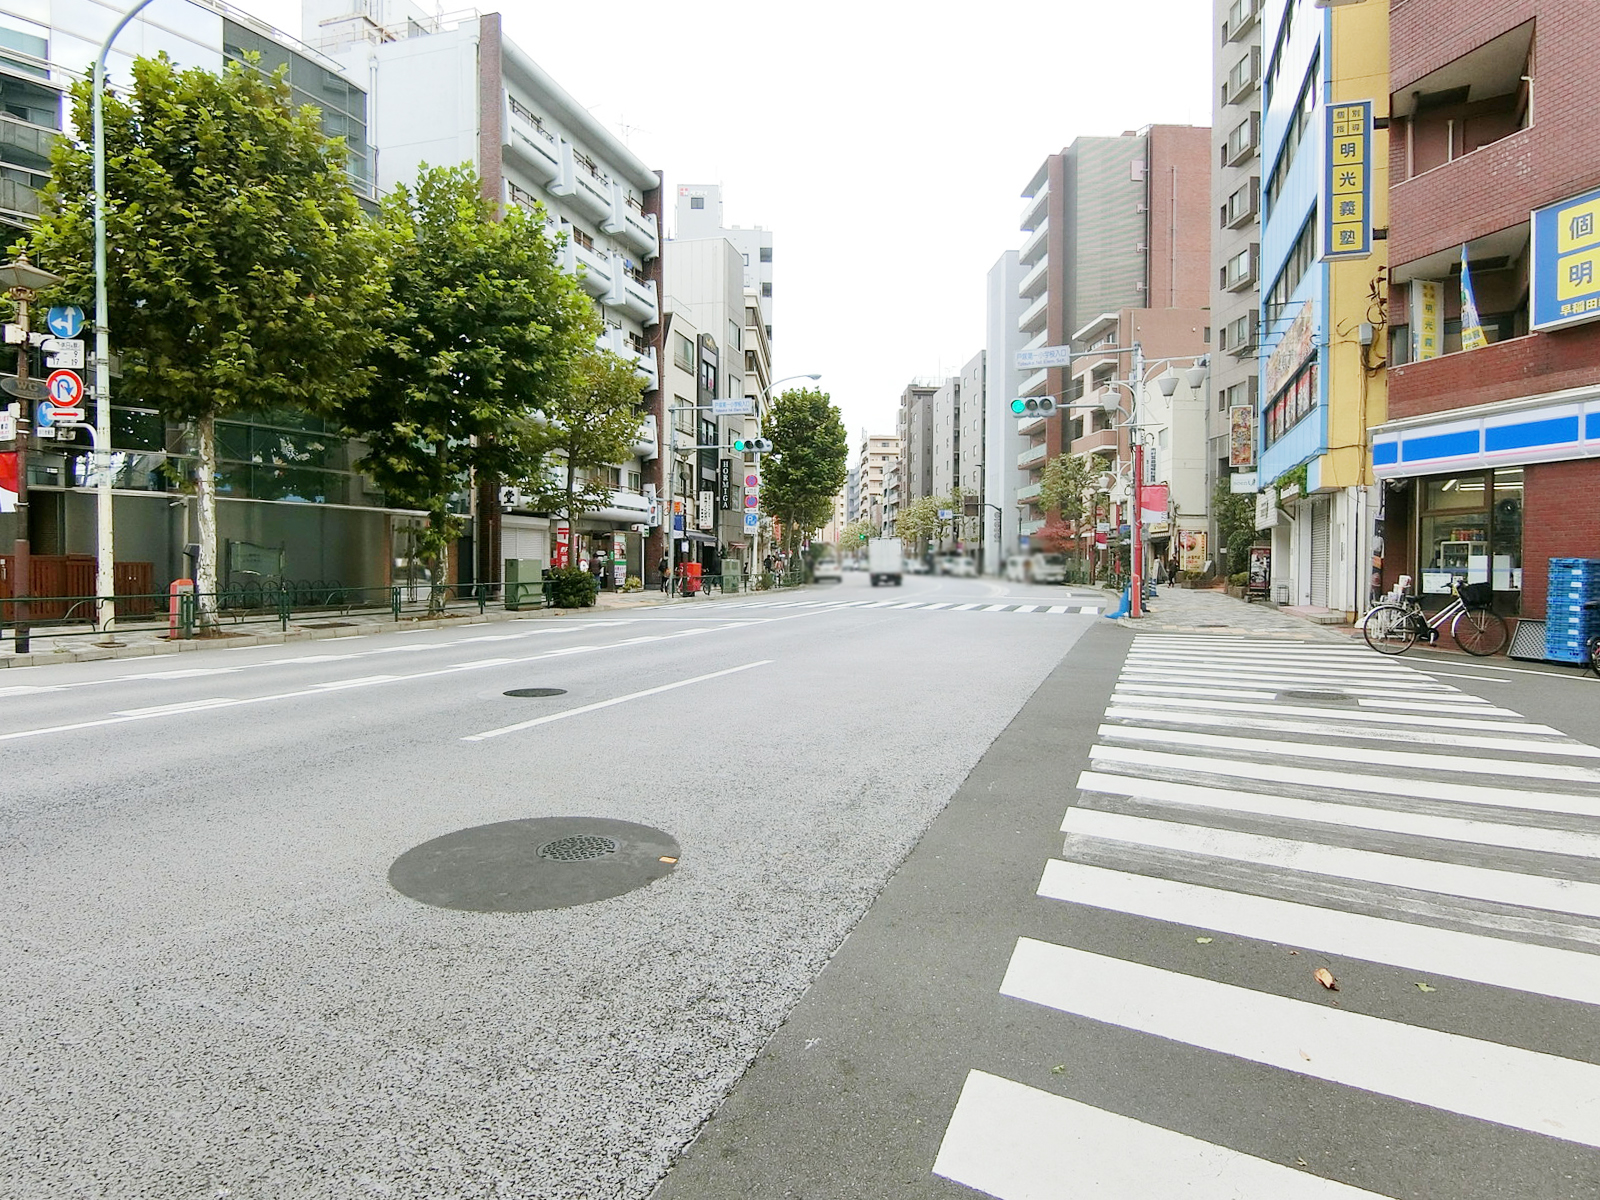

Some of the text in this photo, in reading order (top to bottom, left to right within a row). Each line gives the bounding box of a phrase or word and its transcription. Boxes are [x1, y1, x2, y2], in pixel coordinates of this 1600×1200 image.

[1336, 109, 1360, 119] 個別
[1336, 123, 1360, 134] 指導
[1339, 142, 1356, 245] 明光義塾
[1569, 212, 1593, 240] 個
[1569, 260, 1592, 287] 明
[1560, 297, 1600, 316] 早稲田
